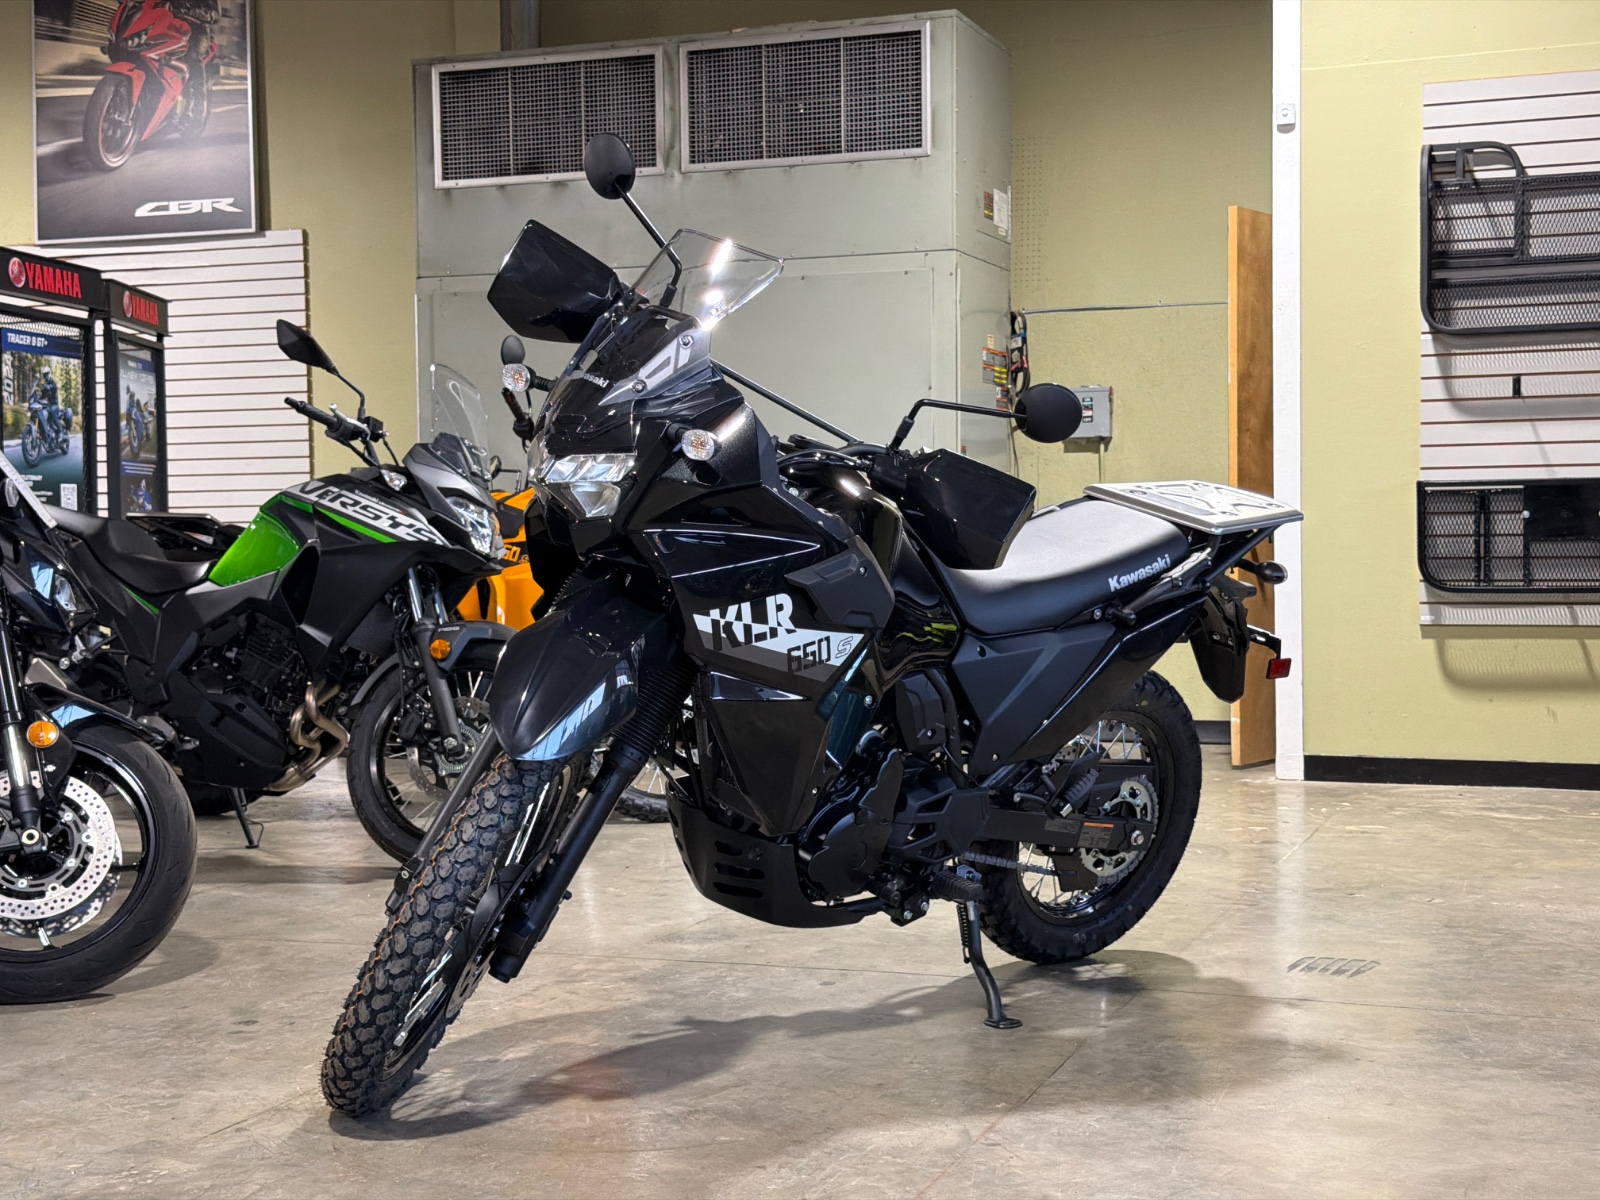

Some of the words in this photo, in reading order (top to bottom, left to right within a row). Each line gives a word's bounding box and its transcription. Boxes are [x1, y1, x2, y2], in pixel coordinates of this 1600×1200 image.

[134, 197, 243, 217] CBR
[25, 262, 82, 299] YAMAHA
[132, 295, 159, 326] YAMAHA
[7, 333, 31, 345] TRACER
[298, 480, 444, 545] VERSYS
[1108, 554, 1171, 592] Kawasaki
[709, 593, 797, 652] KLR
[787, 635, 831, 674] 650
[835, 636, 853, 659] S
